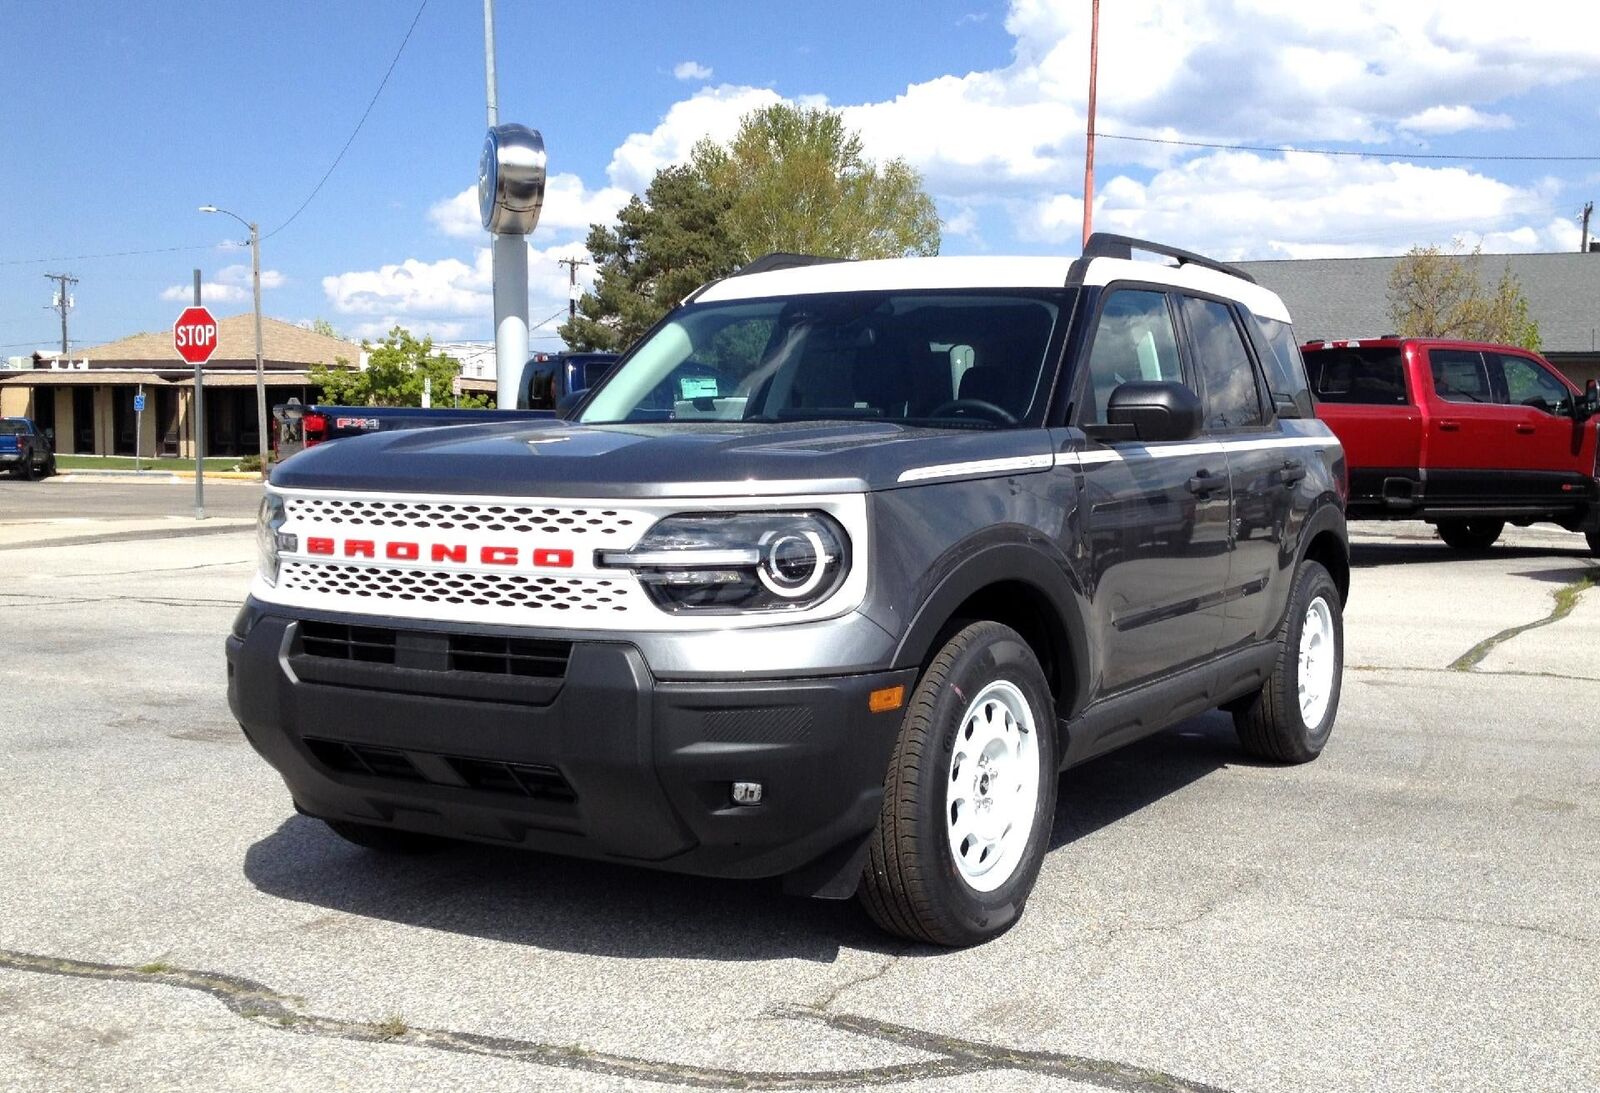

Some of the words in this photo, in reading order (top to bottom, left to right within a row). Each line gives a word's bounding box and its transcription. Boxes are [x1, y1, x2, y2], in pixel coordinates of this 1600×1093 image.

[177, 324, 215, 347] STOP
[336, 418, 380, 430] FX4
[306, 536, 575, 568] BRONCO
